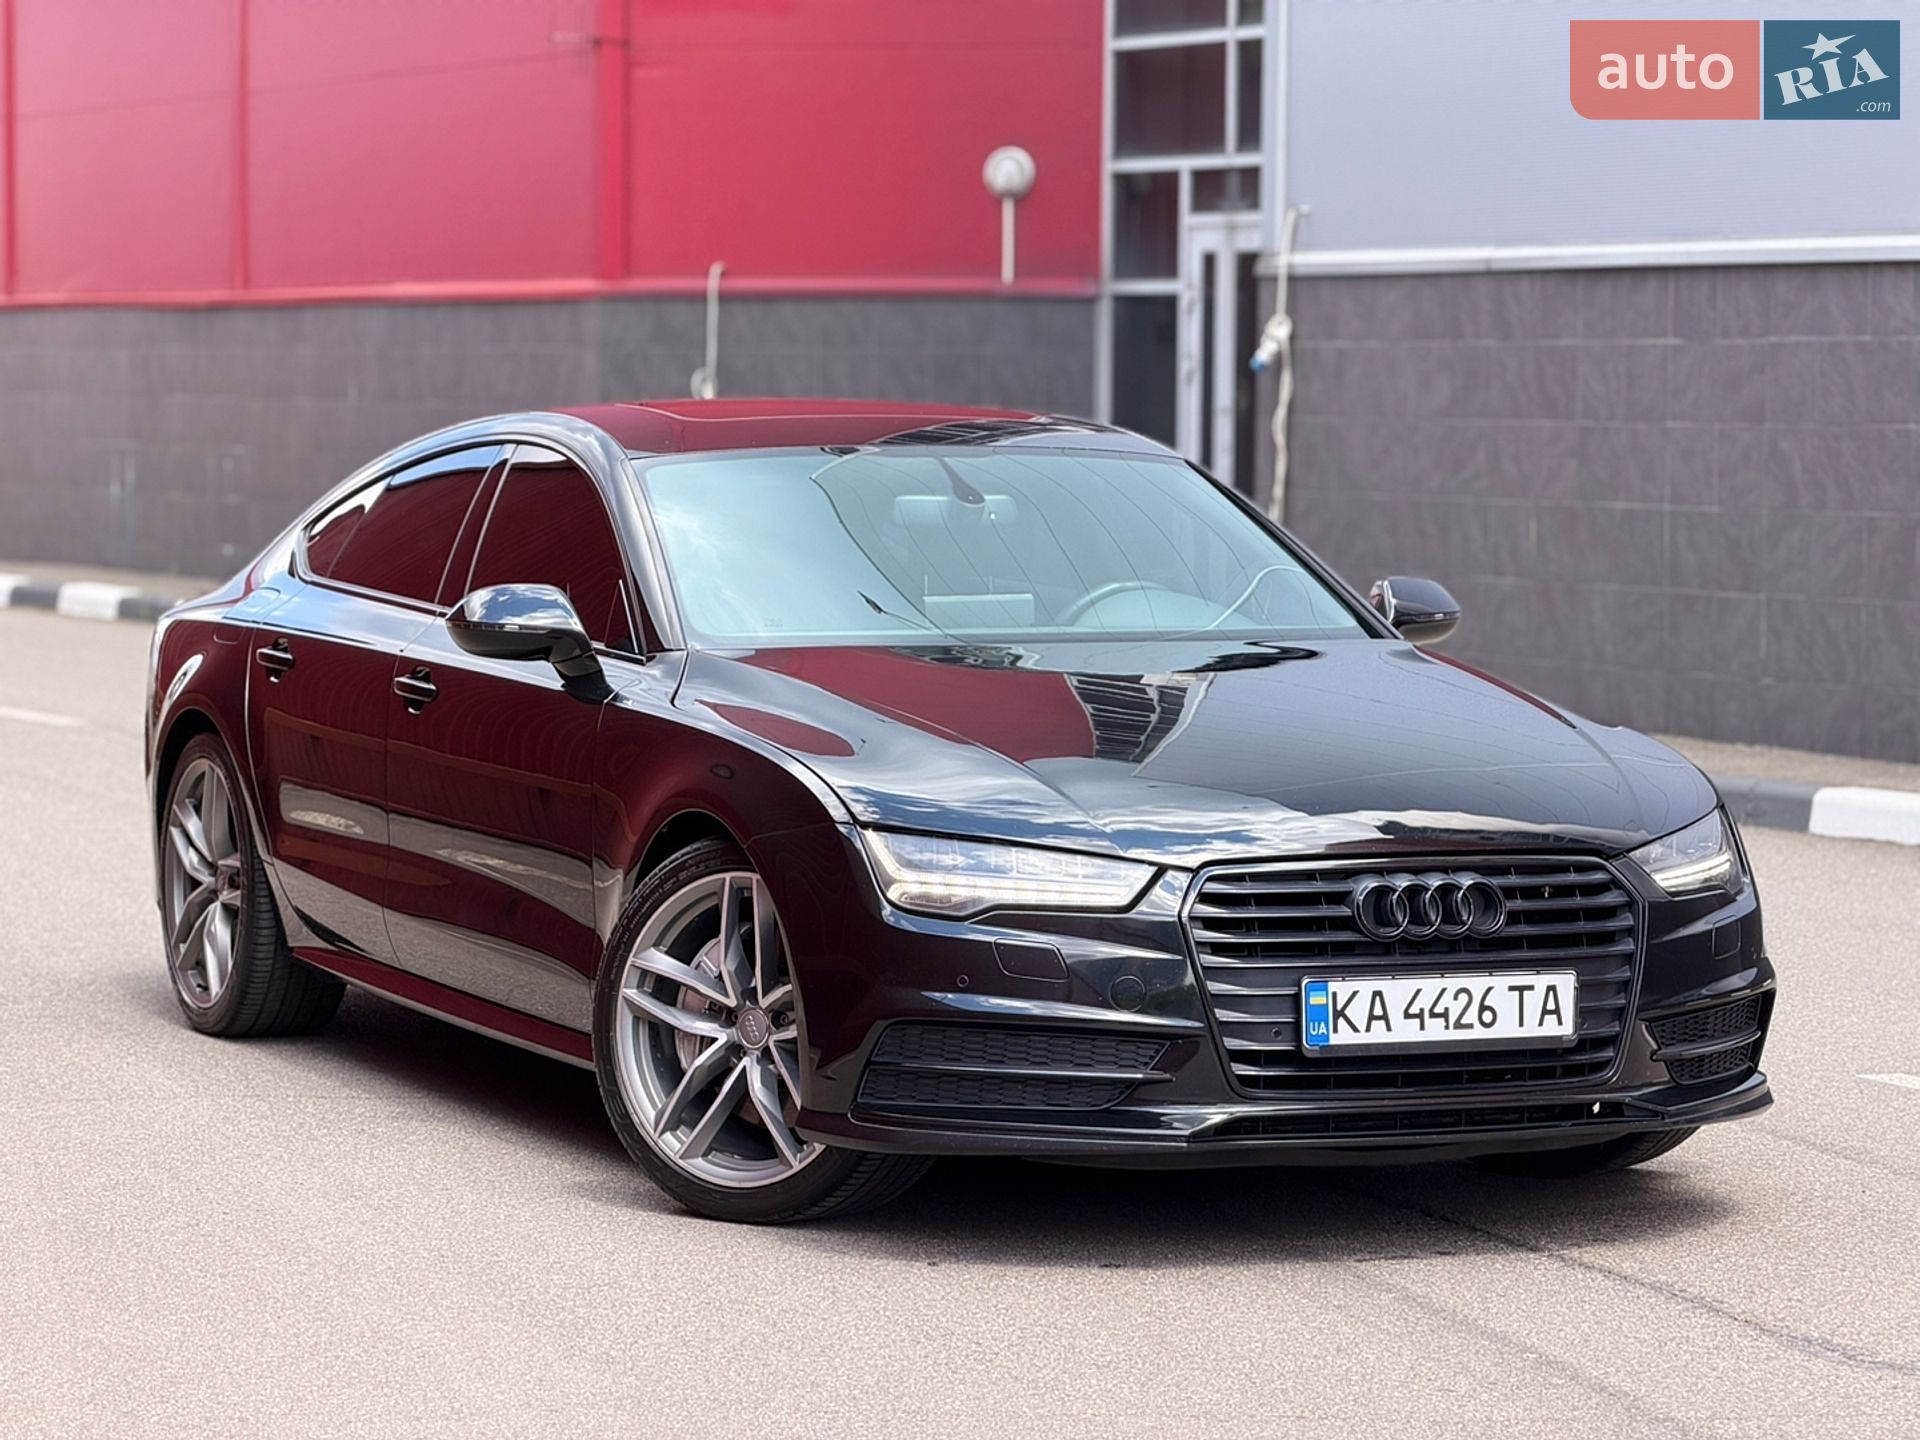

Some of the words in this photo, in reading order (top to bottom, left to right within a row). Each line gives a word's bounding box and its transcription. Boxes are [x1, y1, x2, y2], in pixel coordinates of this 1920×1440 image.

[1331, 989, 1393, 1034] KA
[1403, 986, 1498, 1031] 4426
[1507, 984, 1564, 1028] TA
[1309, 1021, 1328, 1035] UA
